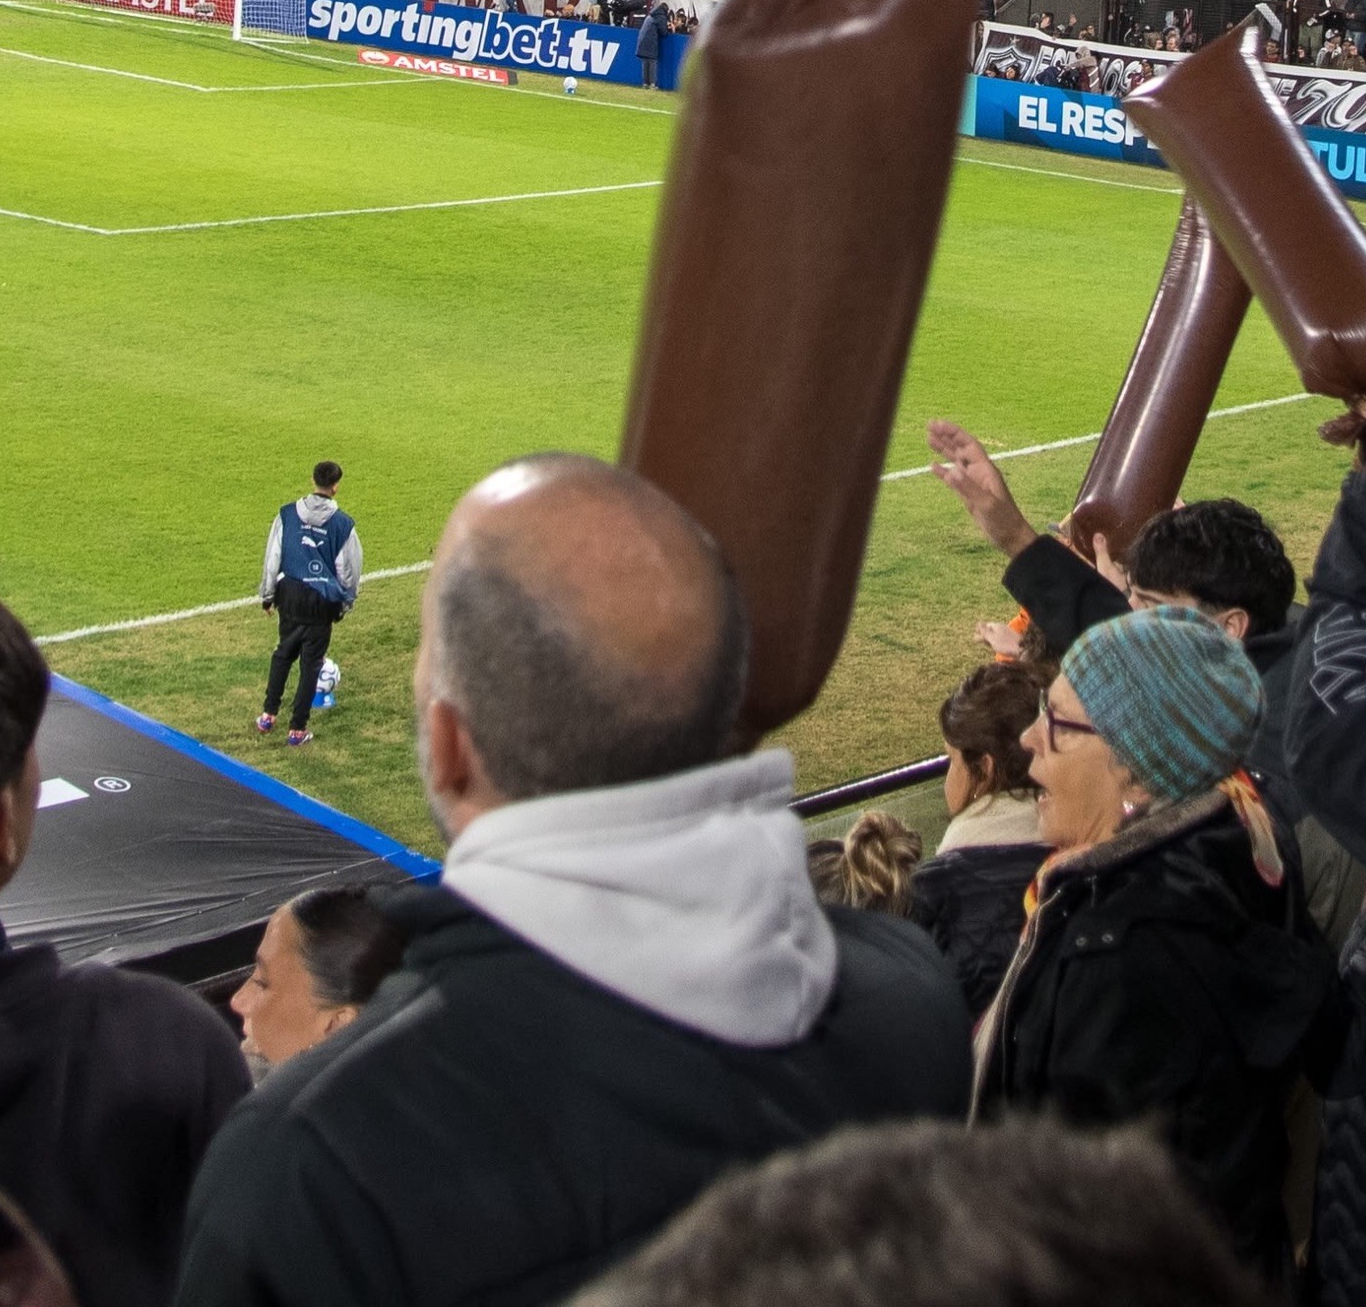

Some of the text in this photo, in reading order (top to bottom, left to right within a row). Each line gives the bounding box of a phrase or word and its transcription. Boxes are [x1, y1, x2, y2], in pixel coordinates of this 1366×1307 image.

[309, 0, 620, 75] sportingbet.tv
[394, 56, 507, 84] AMSTEL
[1019, 95, 1161, 150] EL RESP
